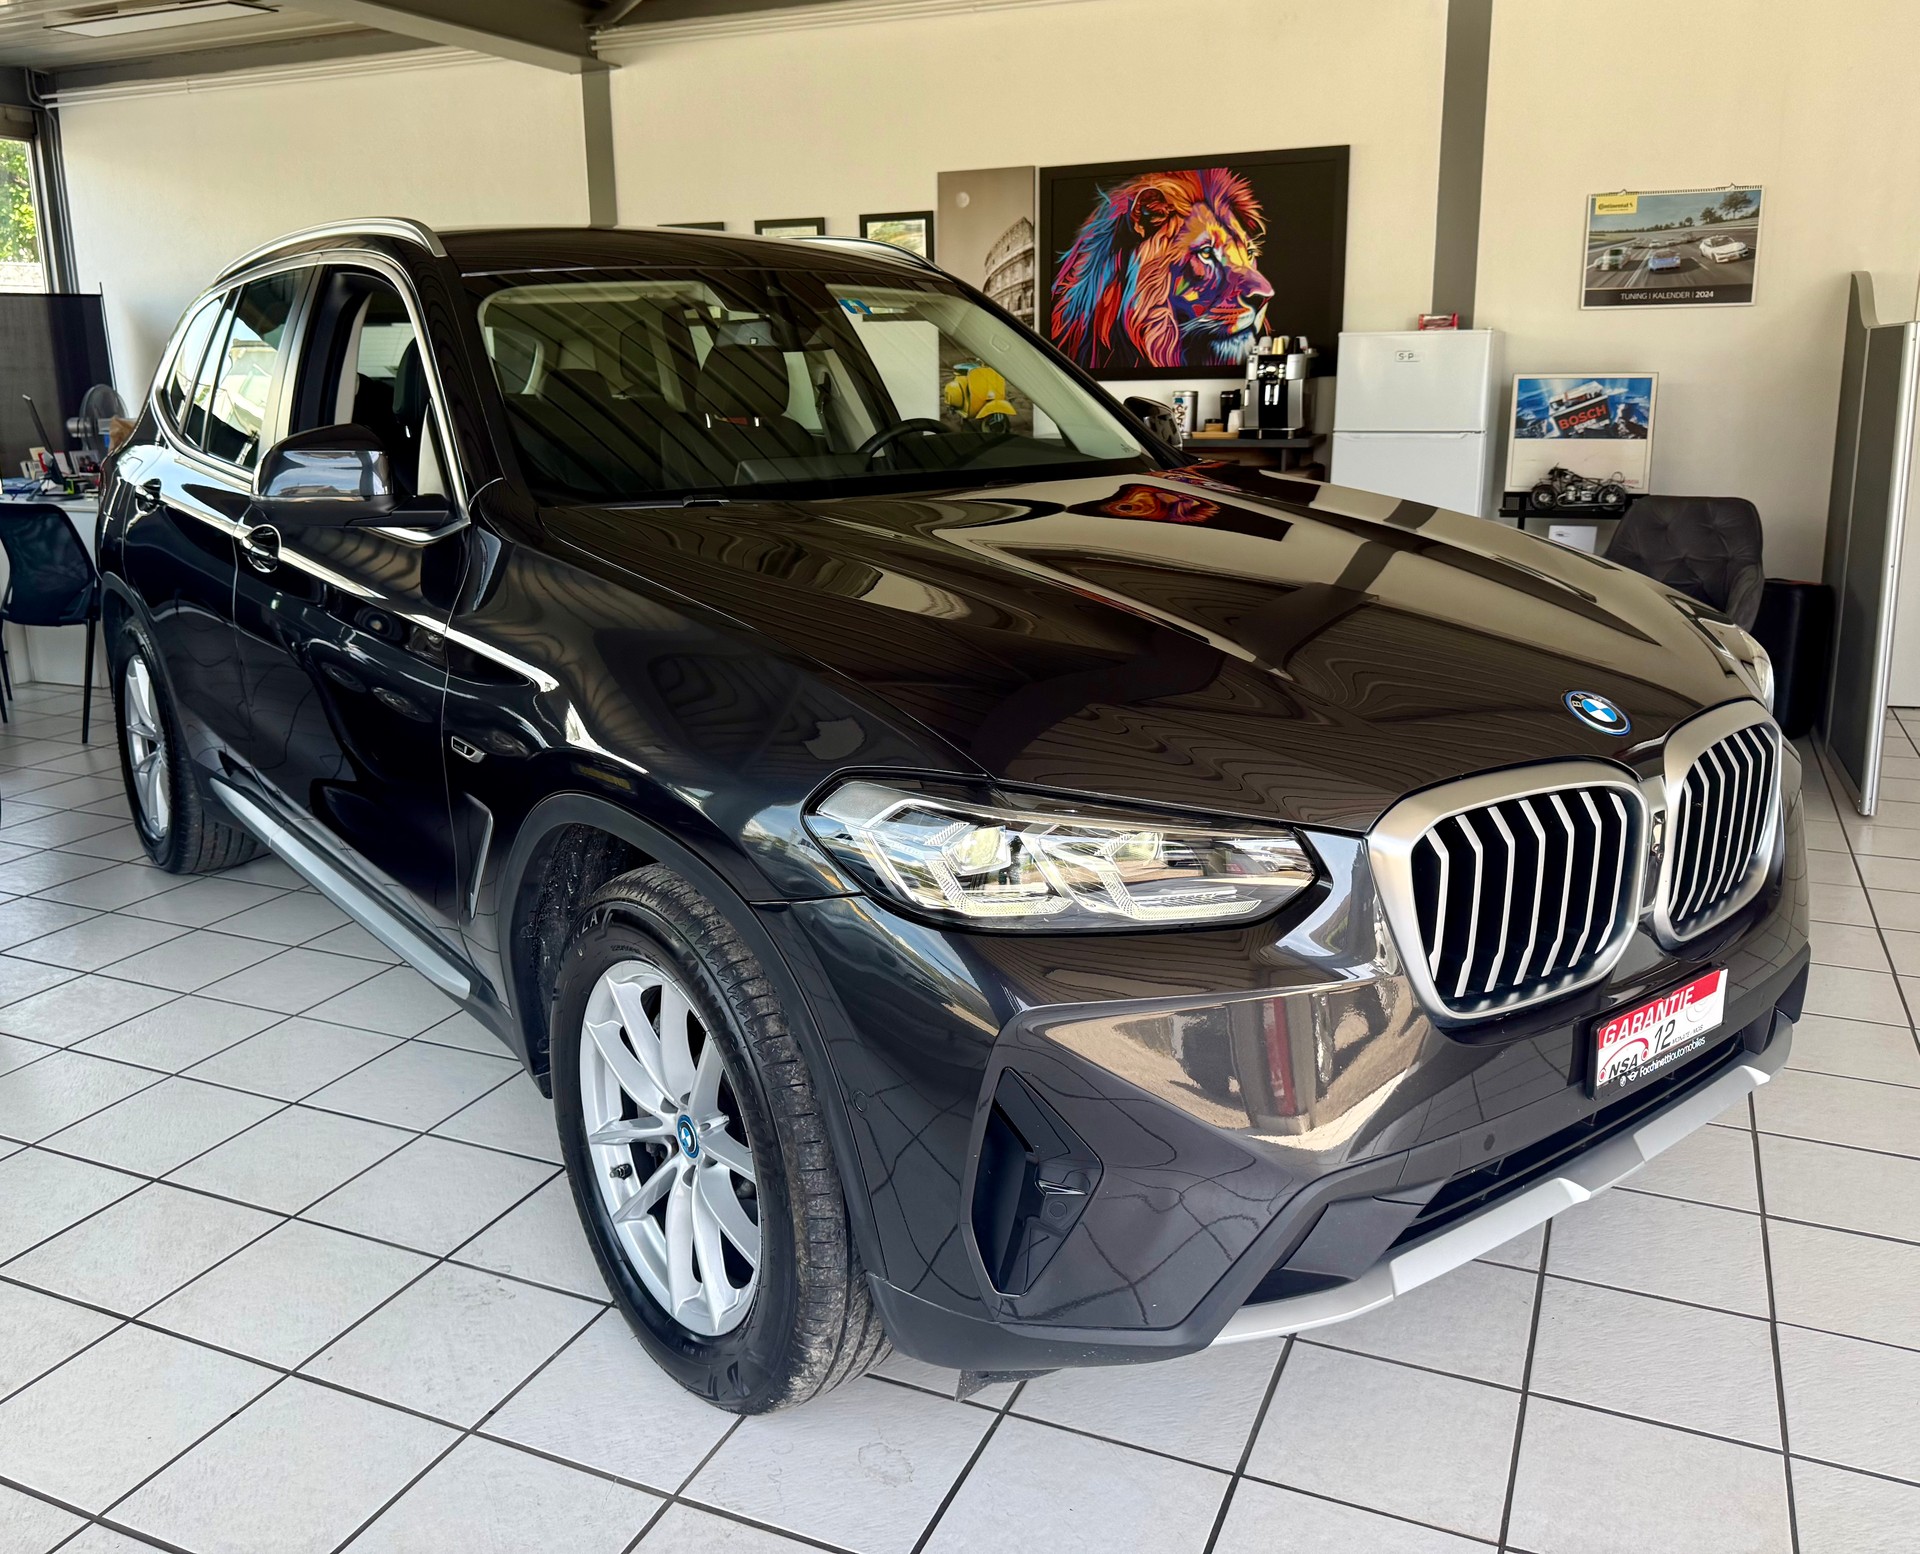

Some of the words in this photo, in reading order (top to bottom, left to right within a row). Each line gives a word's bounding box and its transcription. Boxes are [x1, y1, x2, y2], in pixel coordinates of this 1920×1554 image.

[1695, 290, 1714, 298] 2024
[1558, 404, 1607, 430] BOSCH
[1603, 986, 1695, 1045] GARANTIE
[1654, 1019, 1676, 1054] 12
[1609, 1053, 1638, 1079] NSA
